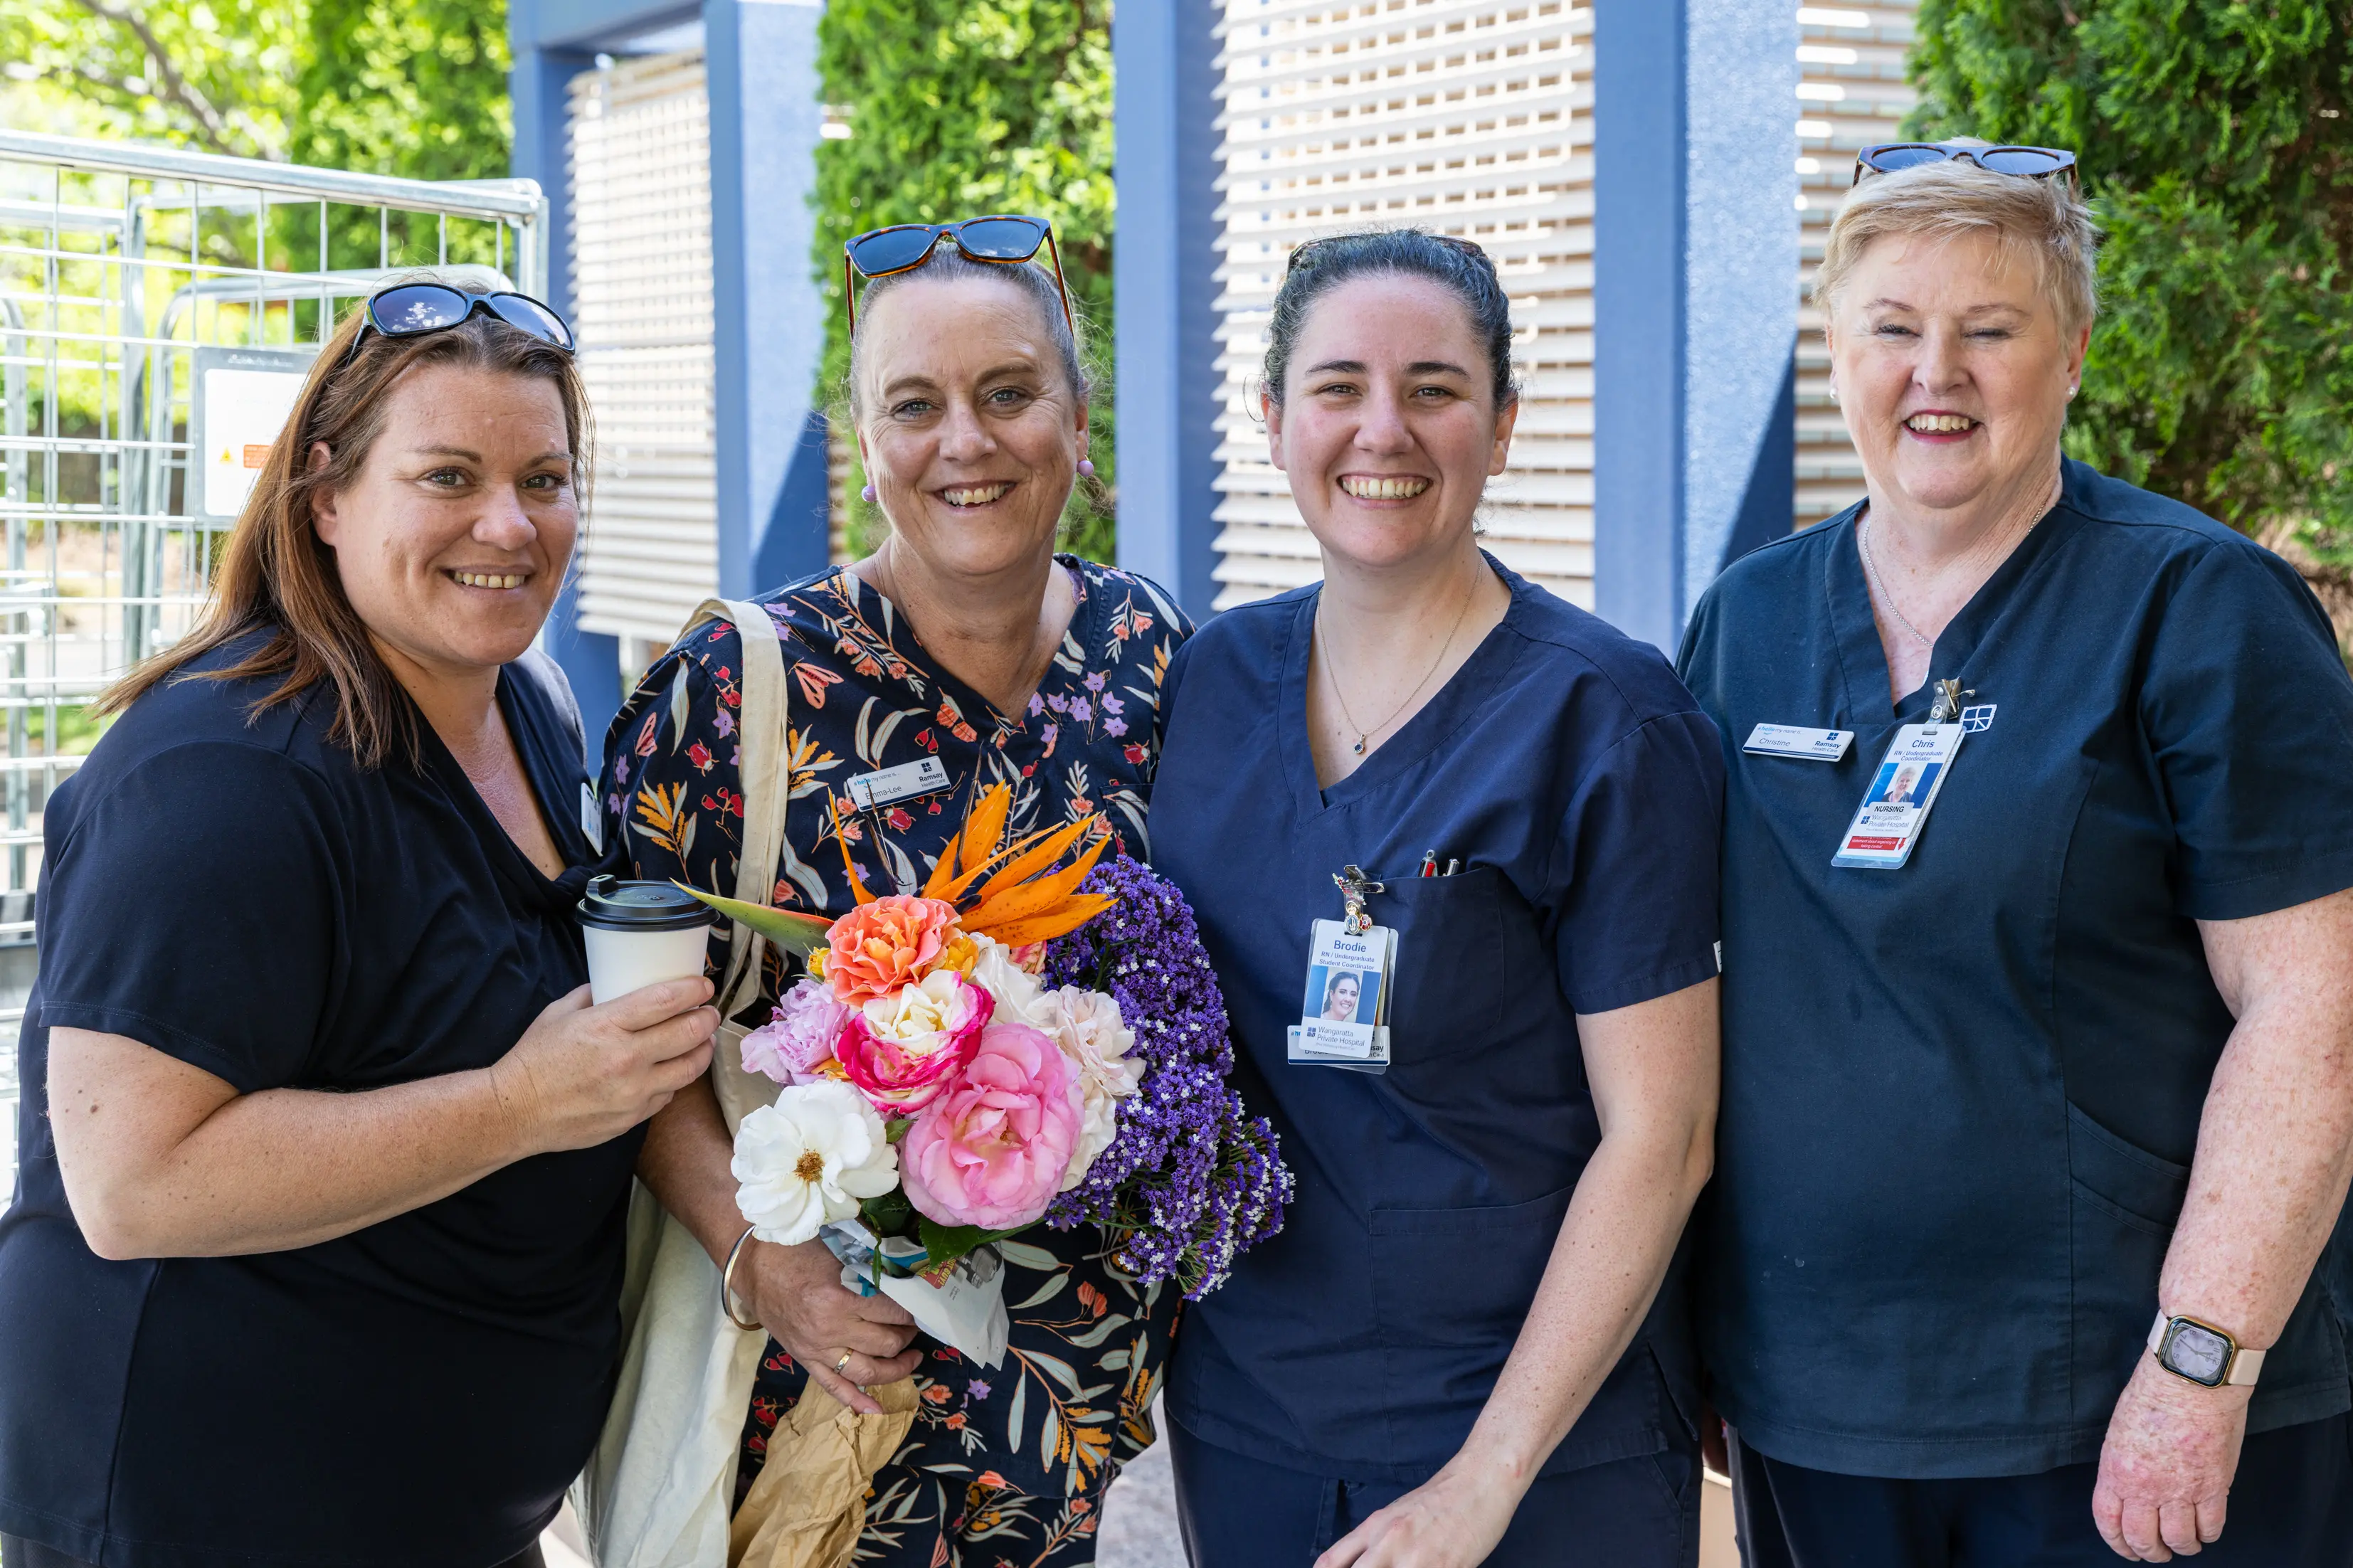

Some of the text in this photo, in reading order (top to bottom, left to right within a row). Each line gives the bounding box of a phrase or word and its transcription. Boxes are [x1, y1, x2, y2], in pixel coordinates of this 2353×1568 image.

[1759, 738, 1791, 746] Christine
[1814, 741, 1841, 749] Ramsay
[919, 773, 943, 782] Ramsay
[1334, 940, 1366, 953] Brodie
[1335, 953, 1375, 962] Undergraduate
[1342, 961, 1374, 970] Coordinator
[1318, 1027, 1353, 1037] Wangaratta
[1316, 1034, 1338, 1043] Private
[1339, 1037, 1365, 1047] Hospital
[938, 1268, 951, 1286] BUY!
[2212, 1357, 2221, 1366] 12
